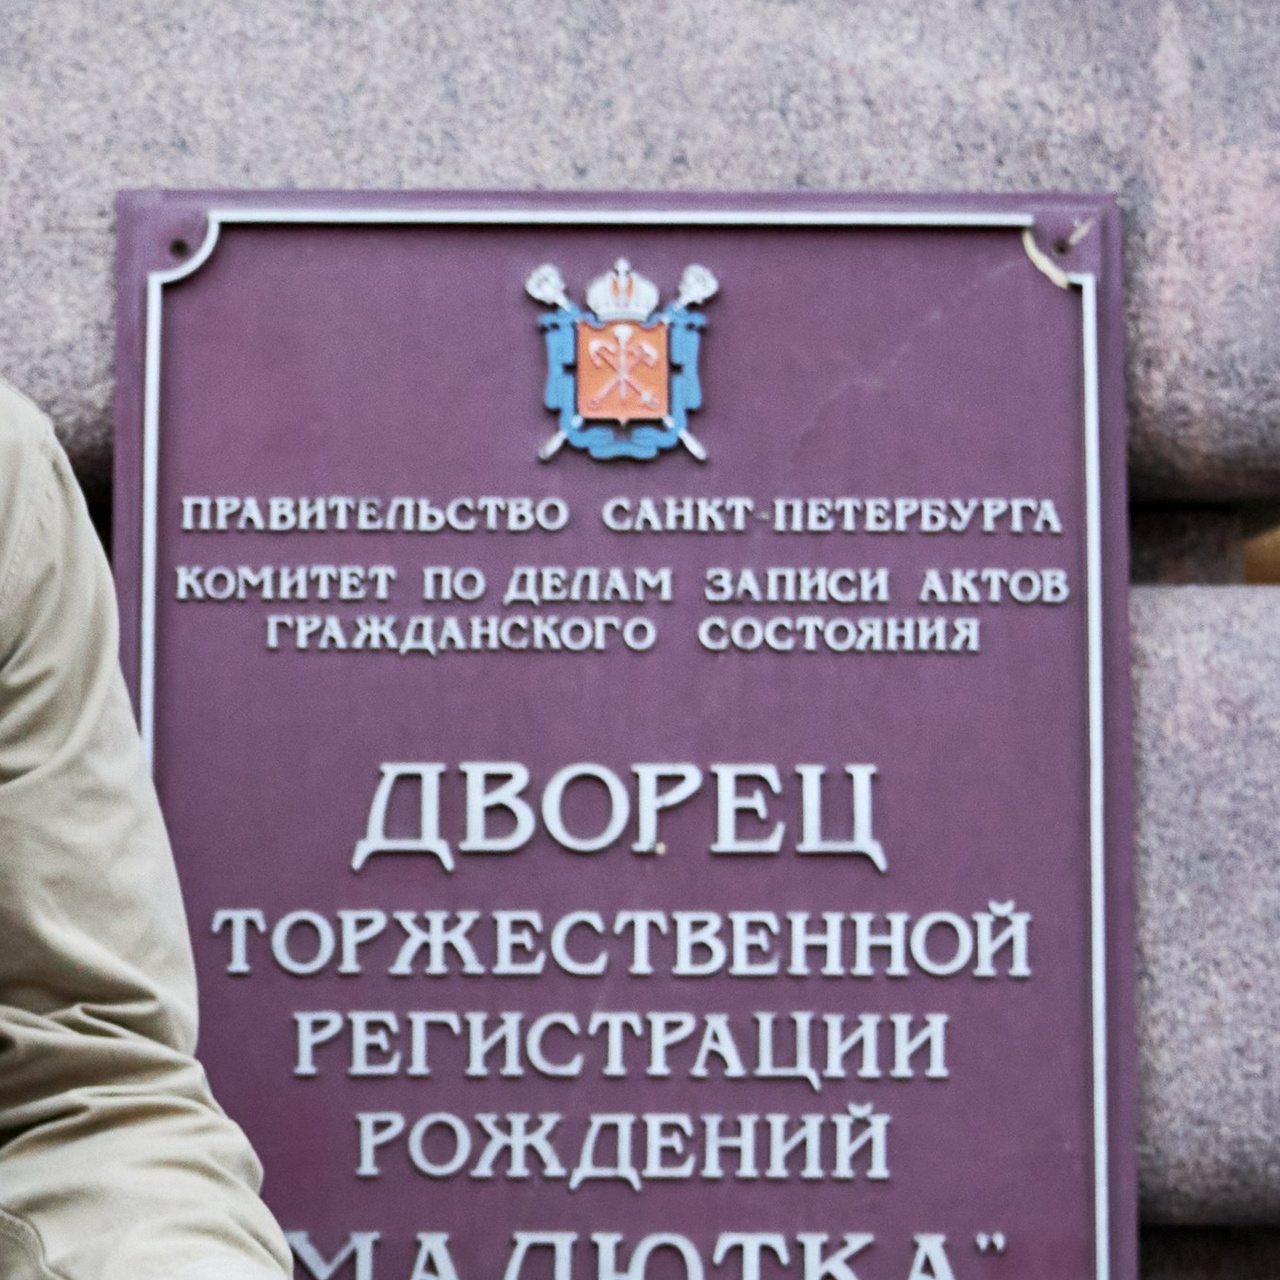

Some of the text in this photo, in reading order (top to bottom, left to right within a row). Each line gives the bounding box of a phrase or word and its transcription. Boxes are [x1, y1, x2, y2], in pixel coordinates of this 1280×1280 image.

[181, 494, 1063, 533] ПРАВИТЕЛЬСТВО САНКТ-ПЕТЕРБУРГА
[175, 564, 1070, 605] КОМИТЕТ ПО ДЕЛАМ ЗАПИСИ АКТОВ
[266, 614, 980, 656] ГРАЖДАНСКОГО СОСТОЯНИЯ
[351, 761, 888, 872] ДВОРЕЦ
[211, 899, 1032, 978] ТОРЖЕСТВЕННОЙ
[292, 1010, 950, 1091] РЕГИСТРАЦИИ
[355, 1102, 892, 1191] РОЖДЕНИЙ
